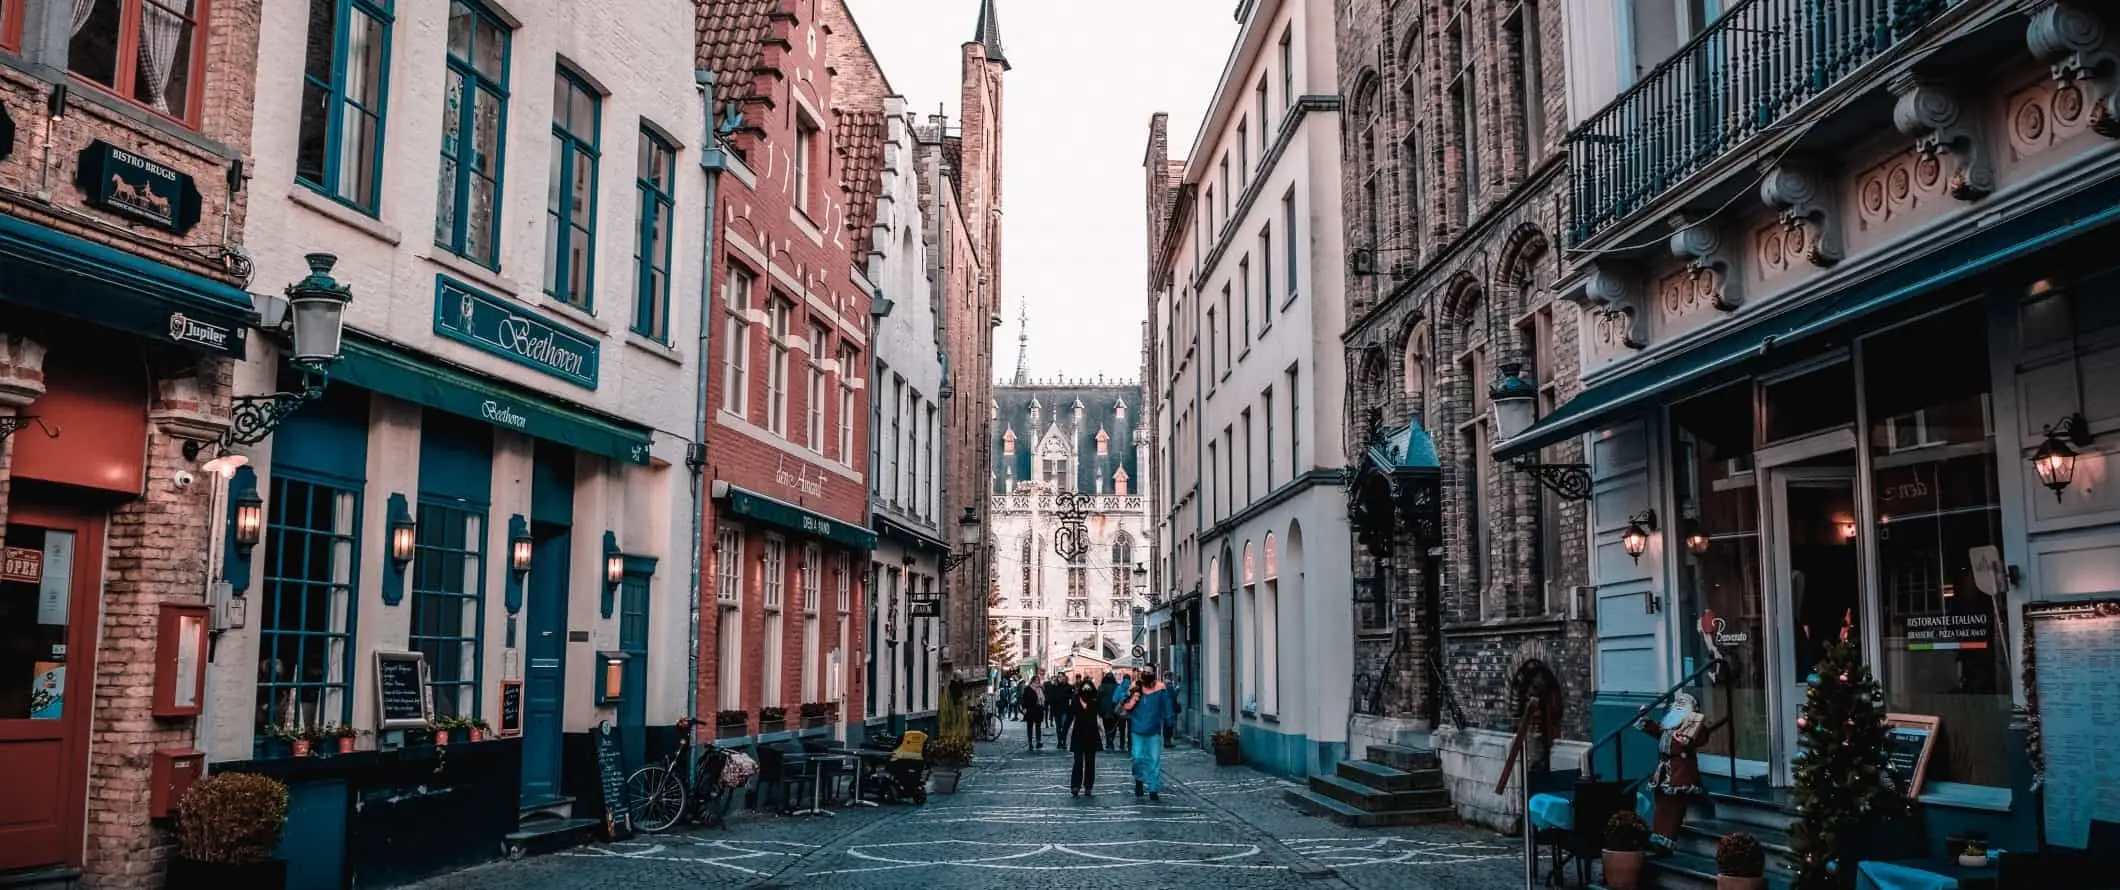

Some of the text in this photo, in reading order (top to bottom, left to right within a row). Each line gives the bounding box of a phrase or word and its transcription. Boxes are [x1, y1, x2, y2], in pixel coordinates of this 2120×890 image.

[112, 148, 177, 181] BISTRO BRUGIS
[186, 321, 227, 343] Jupiler
[498, 313, 583, 376] Beethoven
[481, 399, 527, 428] Beethoven
[6, 559, 39, 577] OPEN
[1906, 614, 1987, 627] RISTORANTE ITALIANO
[1939, 630, 1954, 638] PIZZA
